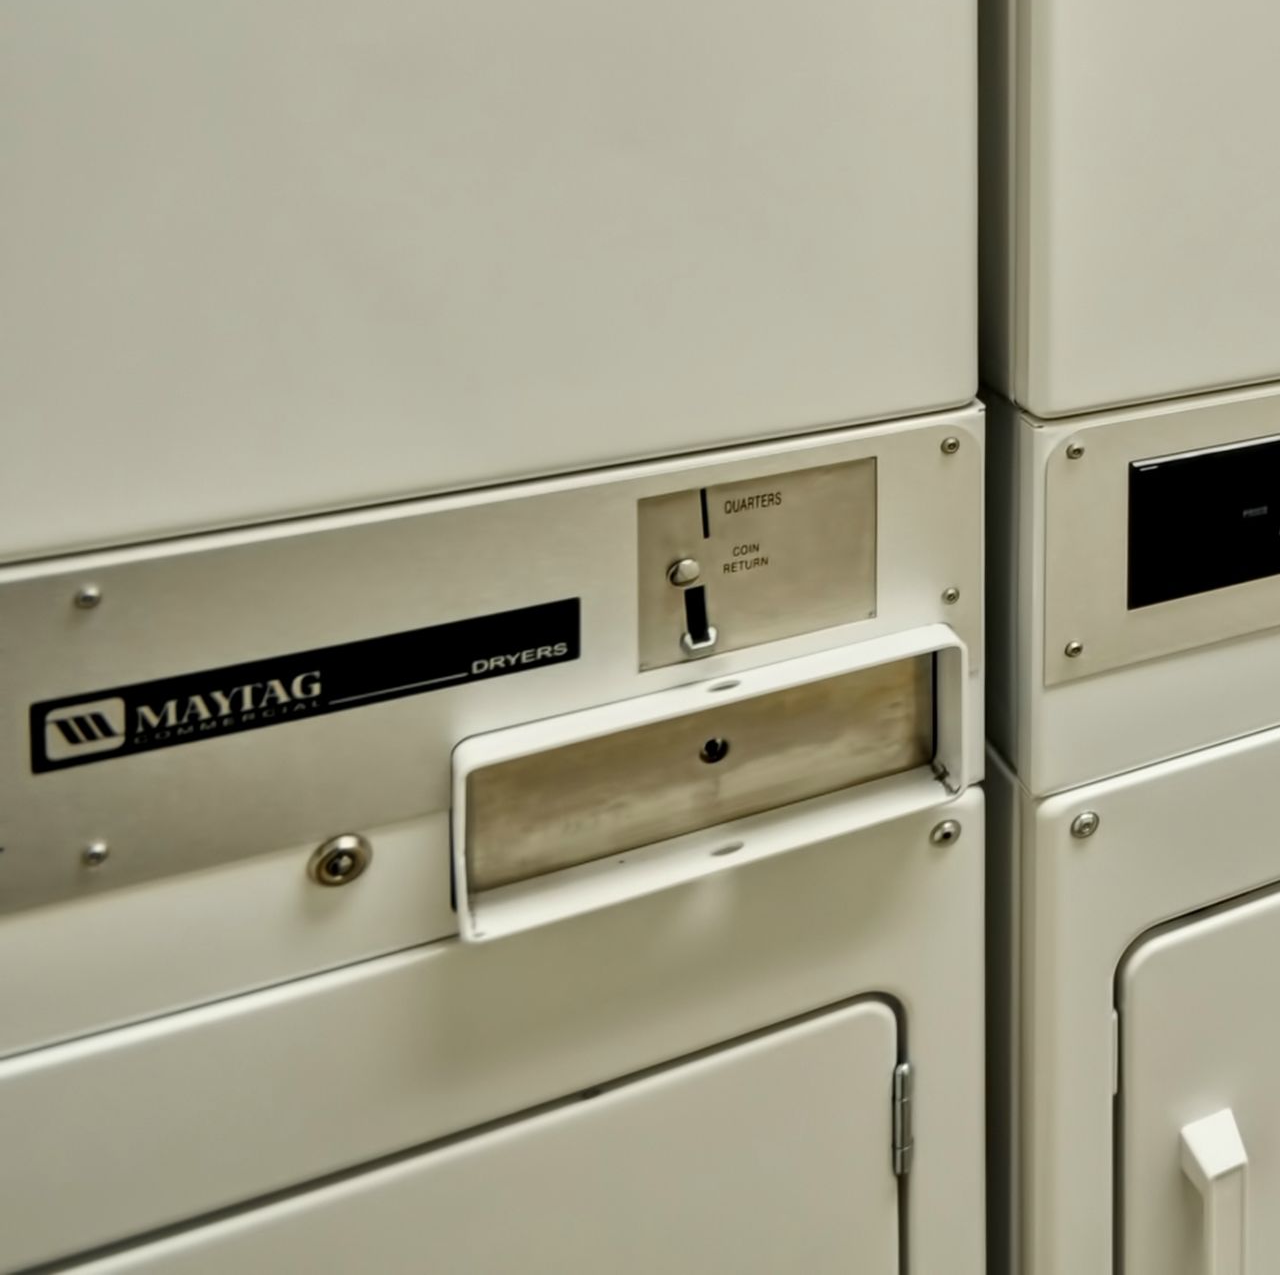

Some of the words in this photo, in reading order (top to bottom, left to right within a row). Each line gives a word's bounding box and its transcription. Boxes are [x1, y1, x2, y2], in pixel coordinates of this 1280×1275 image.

[724, 492, 782, 514] QUARTERS
[732, 544, 760, 557] COIN
[722, 556, 769, 574] RETURN
[471, 642, 568, 675] DRYERS
[135, 671, 322, 733] MAYTAG
[134, 699, 321, 746] COMMERCIAL
